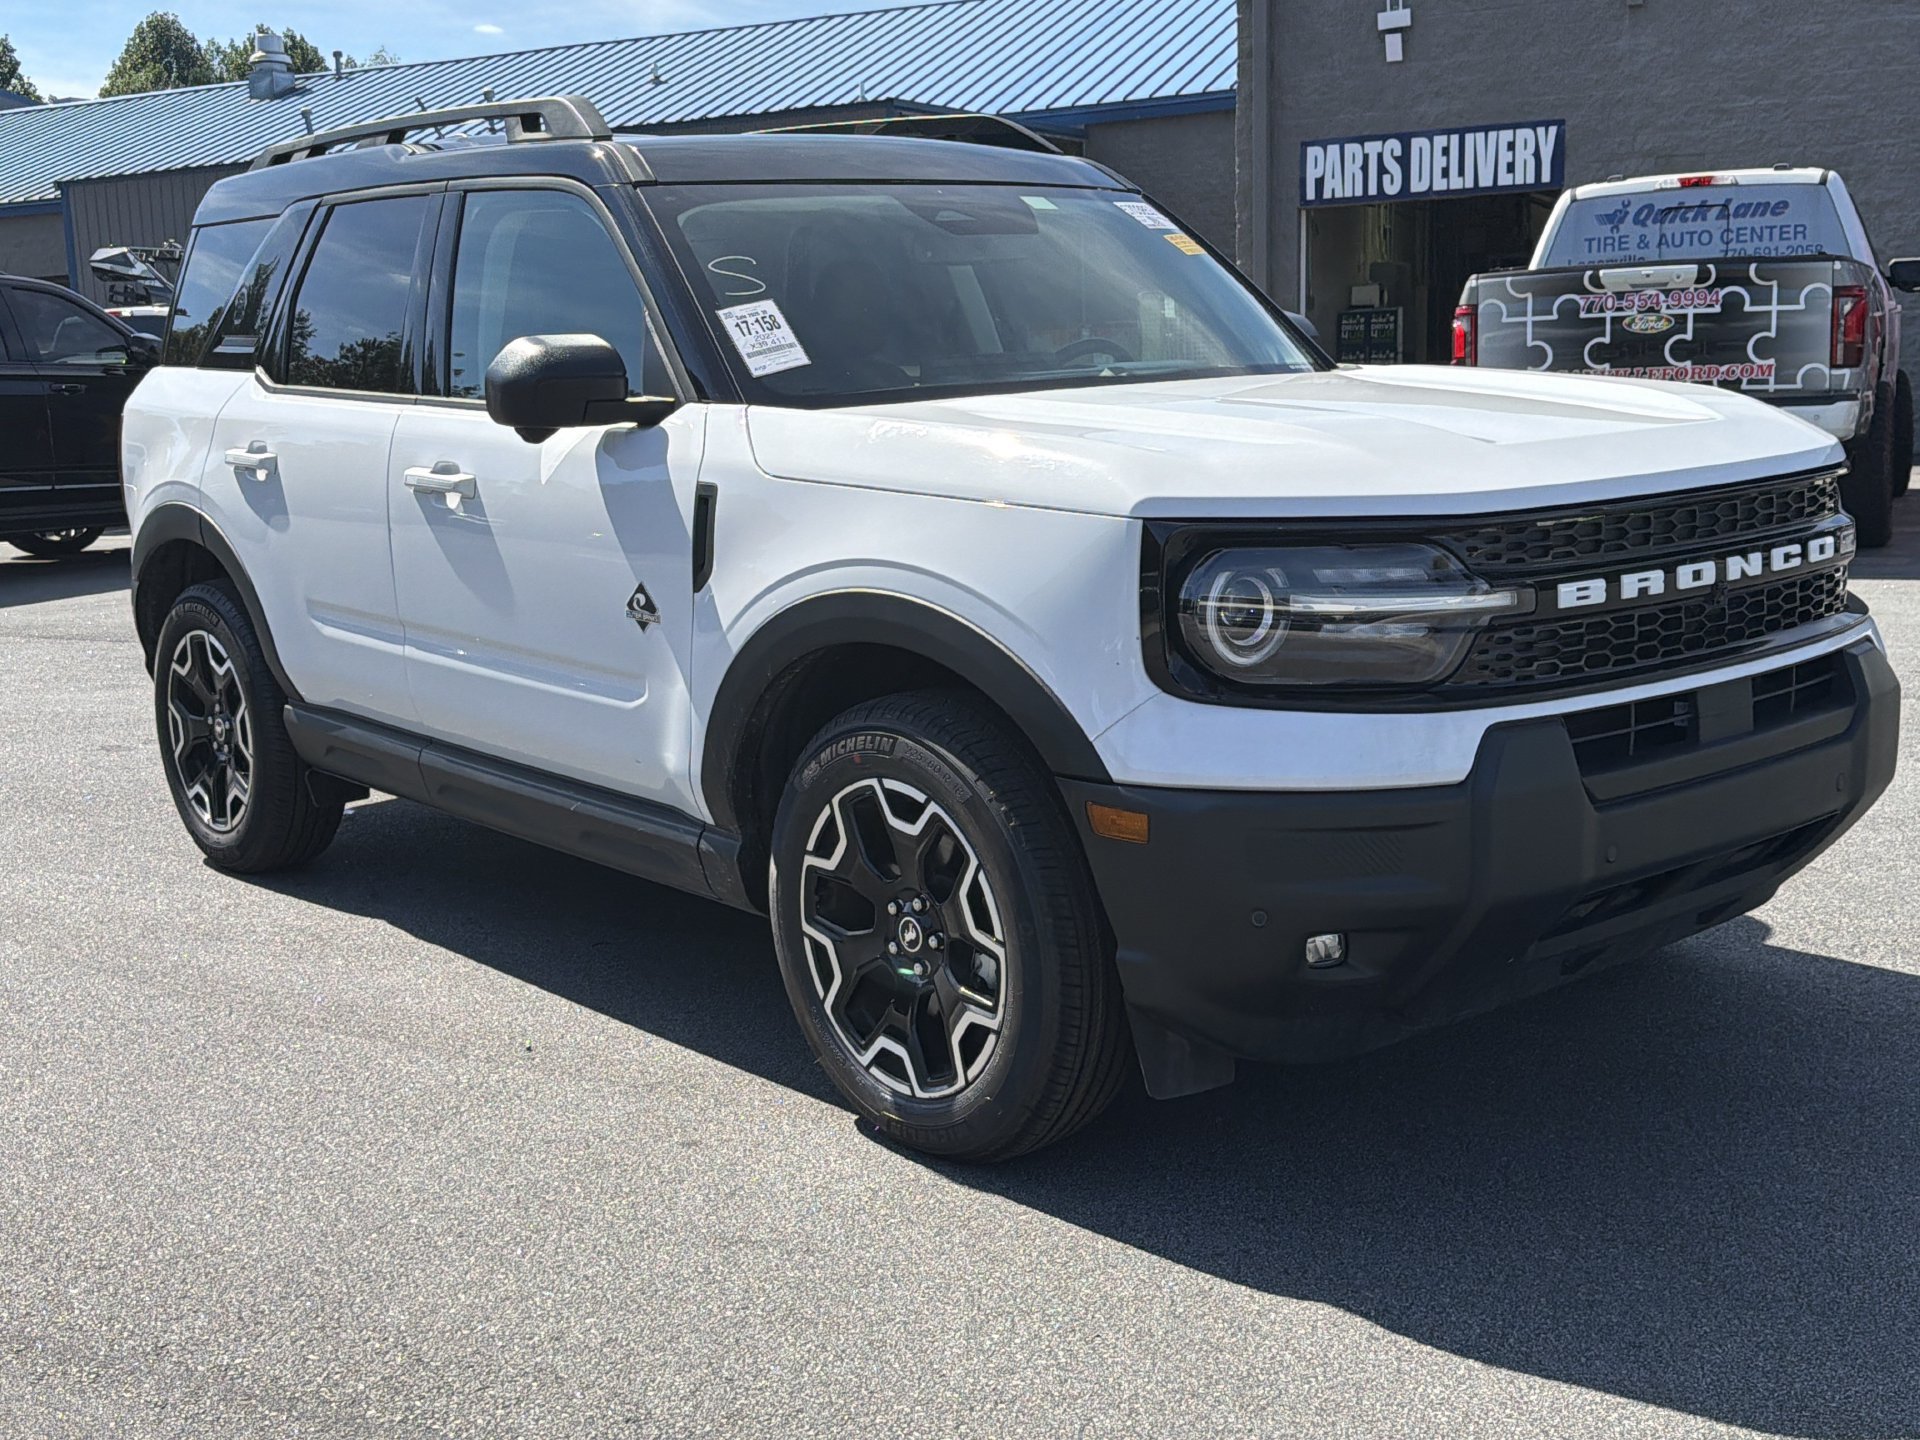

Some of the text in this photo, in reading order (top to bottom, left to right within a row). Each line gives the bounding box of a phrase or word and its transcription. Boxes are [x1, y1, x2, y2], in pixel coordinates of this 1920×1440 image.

[1306, 125, 1558, 200] PARTS DELIVERY
[1632, 198, 1791, 227] Quick Lane
[1584, 224, 1807, 254] TIRE & AUTO CENTER
[1580, 289, 1721, 313] 770-554-9994
[1556, 535, 1835, 610] BRONCO
[185, 602, 219, 625] MICHELIN
[820, 735, 894, 766] MICHELIN
